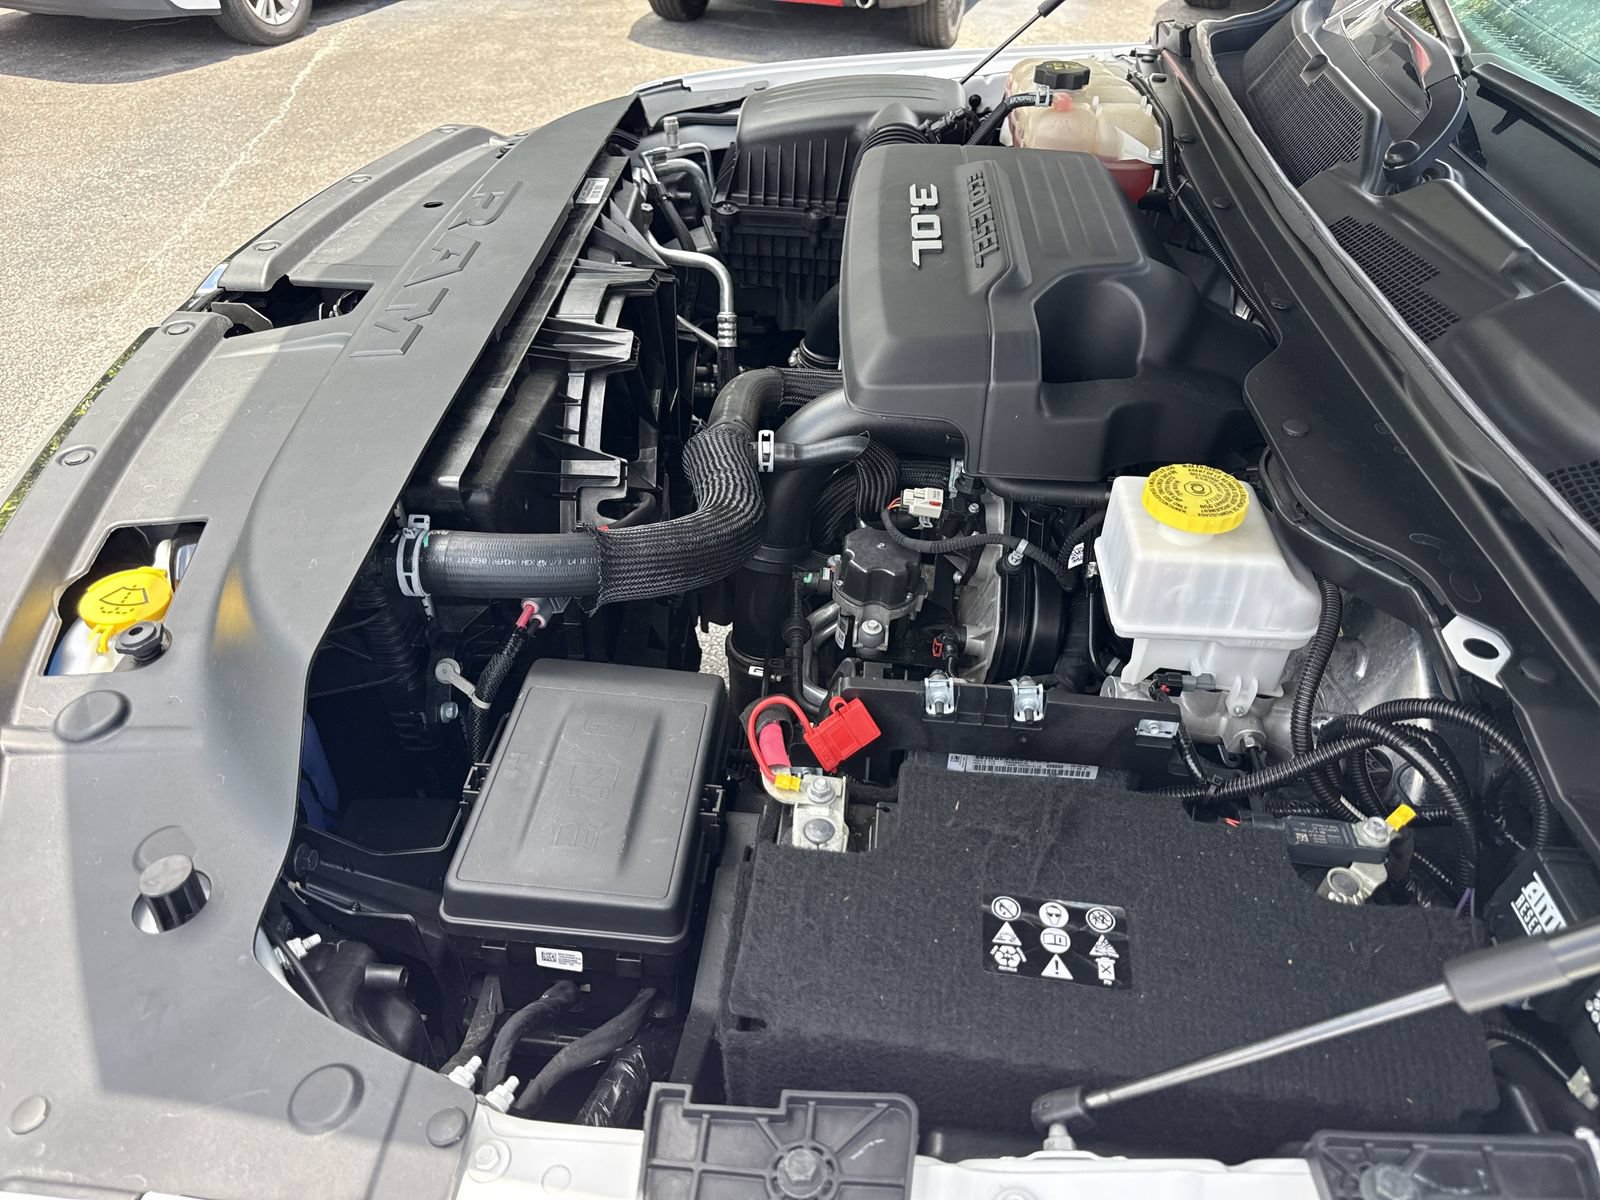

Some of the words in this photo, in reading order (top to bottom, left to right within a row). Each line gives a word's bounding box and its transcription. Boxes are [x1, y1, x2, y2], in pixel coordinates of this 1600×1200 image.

[349, 180, 523, 358] RAM
[909, 183, 944, 271] 3.0L
[966, 171, 1000, 269] ECODIESEL
